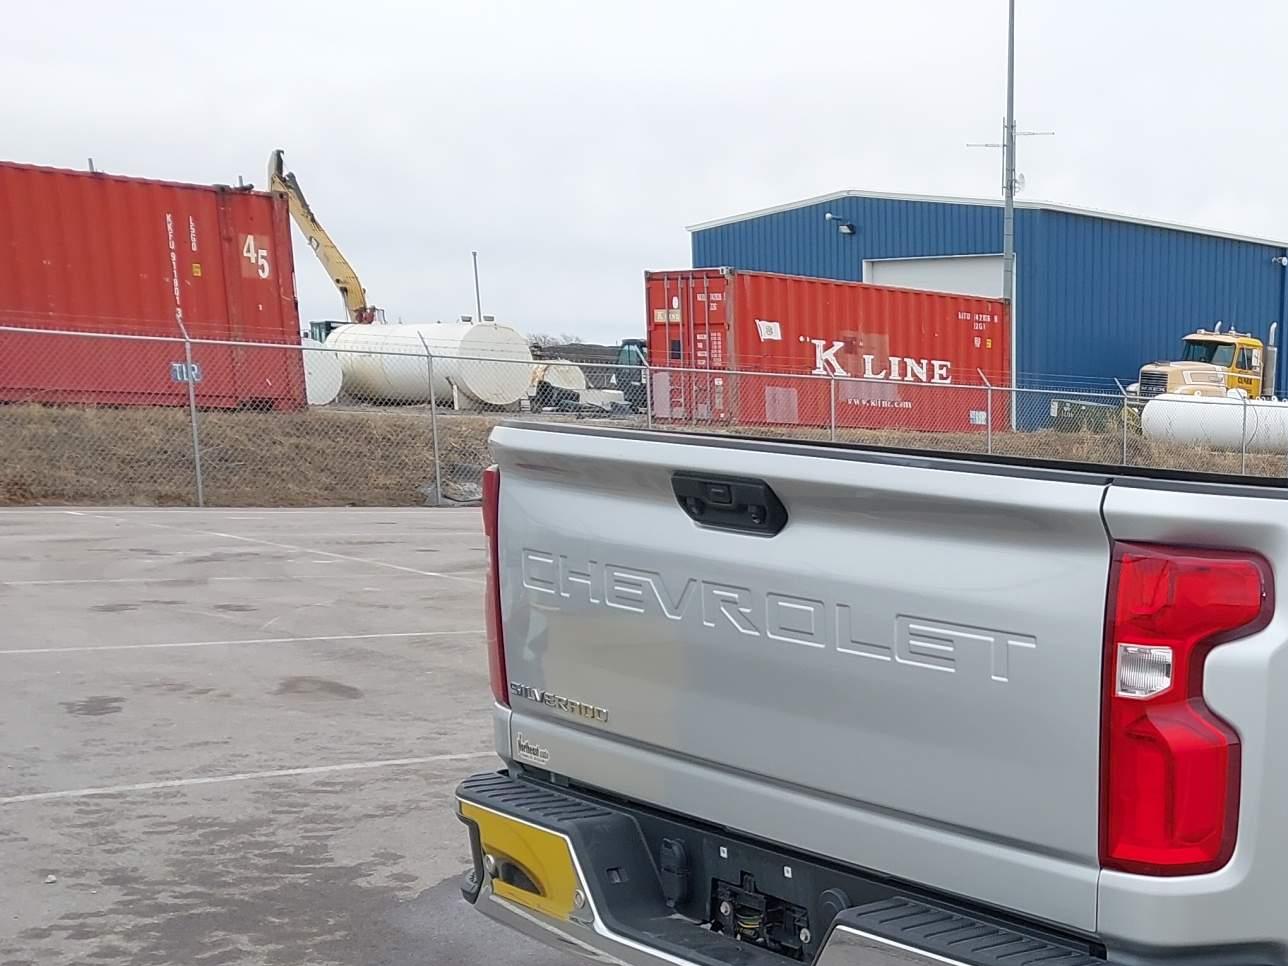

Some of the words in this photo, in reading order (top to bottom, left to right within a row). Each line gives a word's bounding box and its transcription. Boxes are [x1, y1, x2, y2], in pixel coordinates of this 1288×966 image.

[243, 234, 270, 278] 45
[863, 355, 952, 384] LINE
[522, 547, 1038, 682] CHEVROLET
[511, 681, 609, 722] SILVERADO
